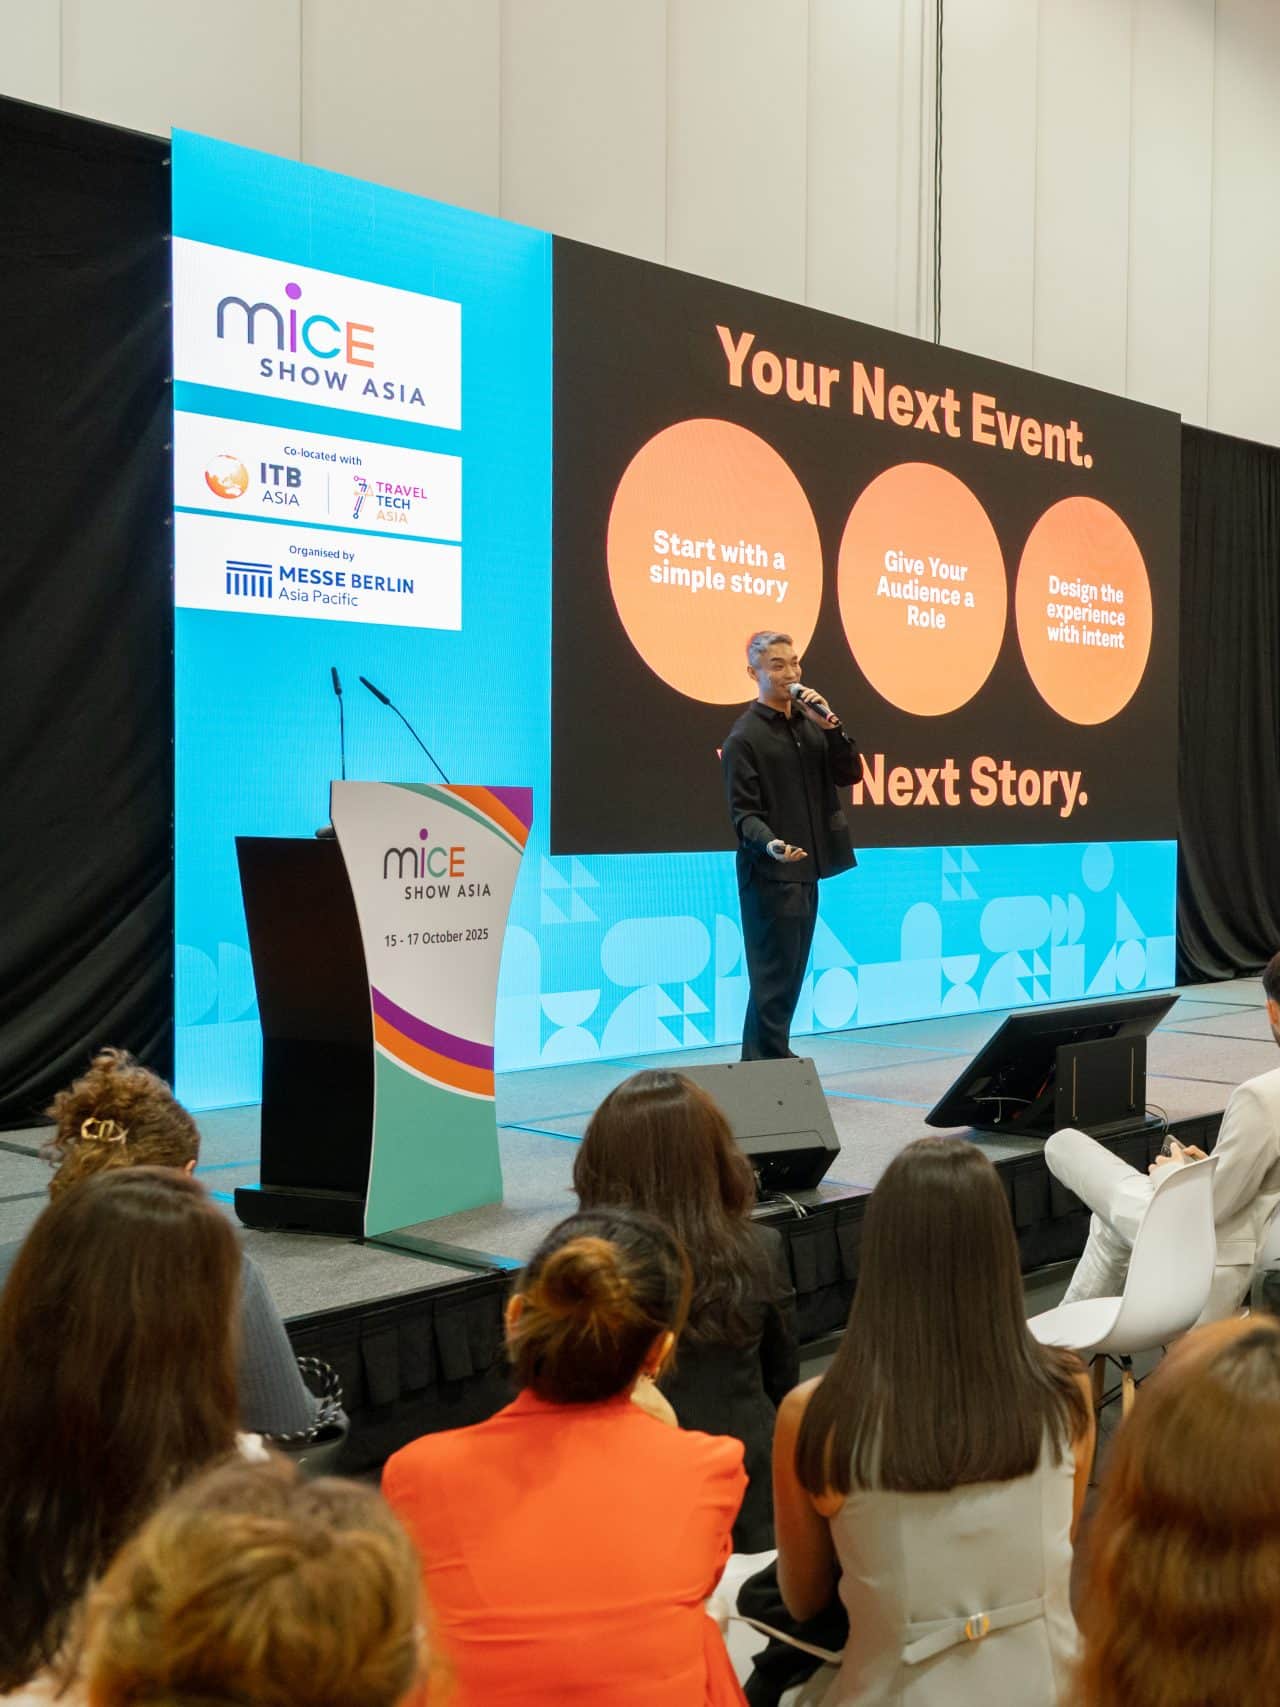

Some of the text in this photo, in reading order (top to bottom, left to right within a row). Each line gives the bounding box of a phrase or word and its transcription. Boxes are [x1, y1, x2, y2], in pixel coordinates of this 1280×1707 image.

[259, 358, 426, 407] SHOW ASIA
[715, 324, 1093, 469] Your Next Event.
[283, 446, 362, 466] Co-located with
[260, 462, 302, 488] ITB
[262, 489, 300, 506] ASIA
[376, 481, 428, 499] TRAVEL
[376, 495, 411, 510] TECH
[376, 509, 408, 524] ASIA
[289, 545, 355, 563] Organised by
[653, 529, 787, 571] Start with a
[884, 549, 968, 582] Give Your
[279, 565, 414, 594] MESSE BERLIN
[649, 558, 788, 603] simple story
[876, 575, 975, 608] Audience a
[1048, 575, 1124, 604] Design the
[278, 587, 359, 607] Asia Pacific
[906, 604, 946, 629] Role
[1046, 602, 1126, 628] experience
[1047, 621, 1125, 649] with intent
[852, 753, 1089, 819] Next Story.
[404, 883, 492, 900] SHOW ASIA
[384, 934, 397, 948] 15
[407, 933, 419, 946] 17
[422, 929, 463, 945] October
[465, 928, 489, 942] 2025
